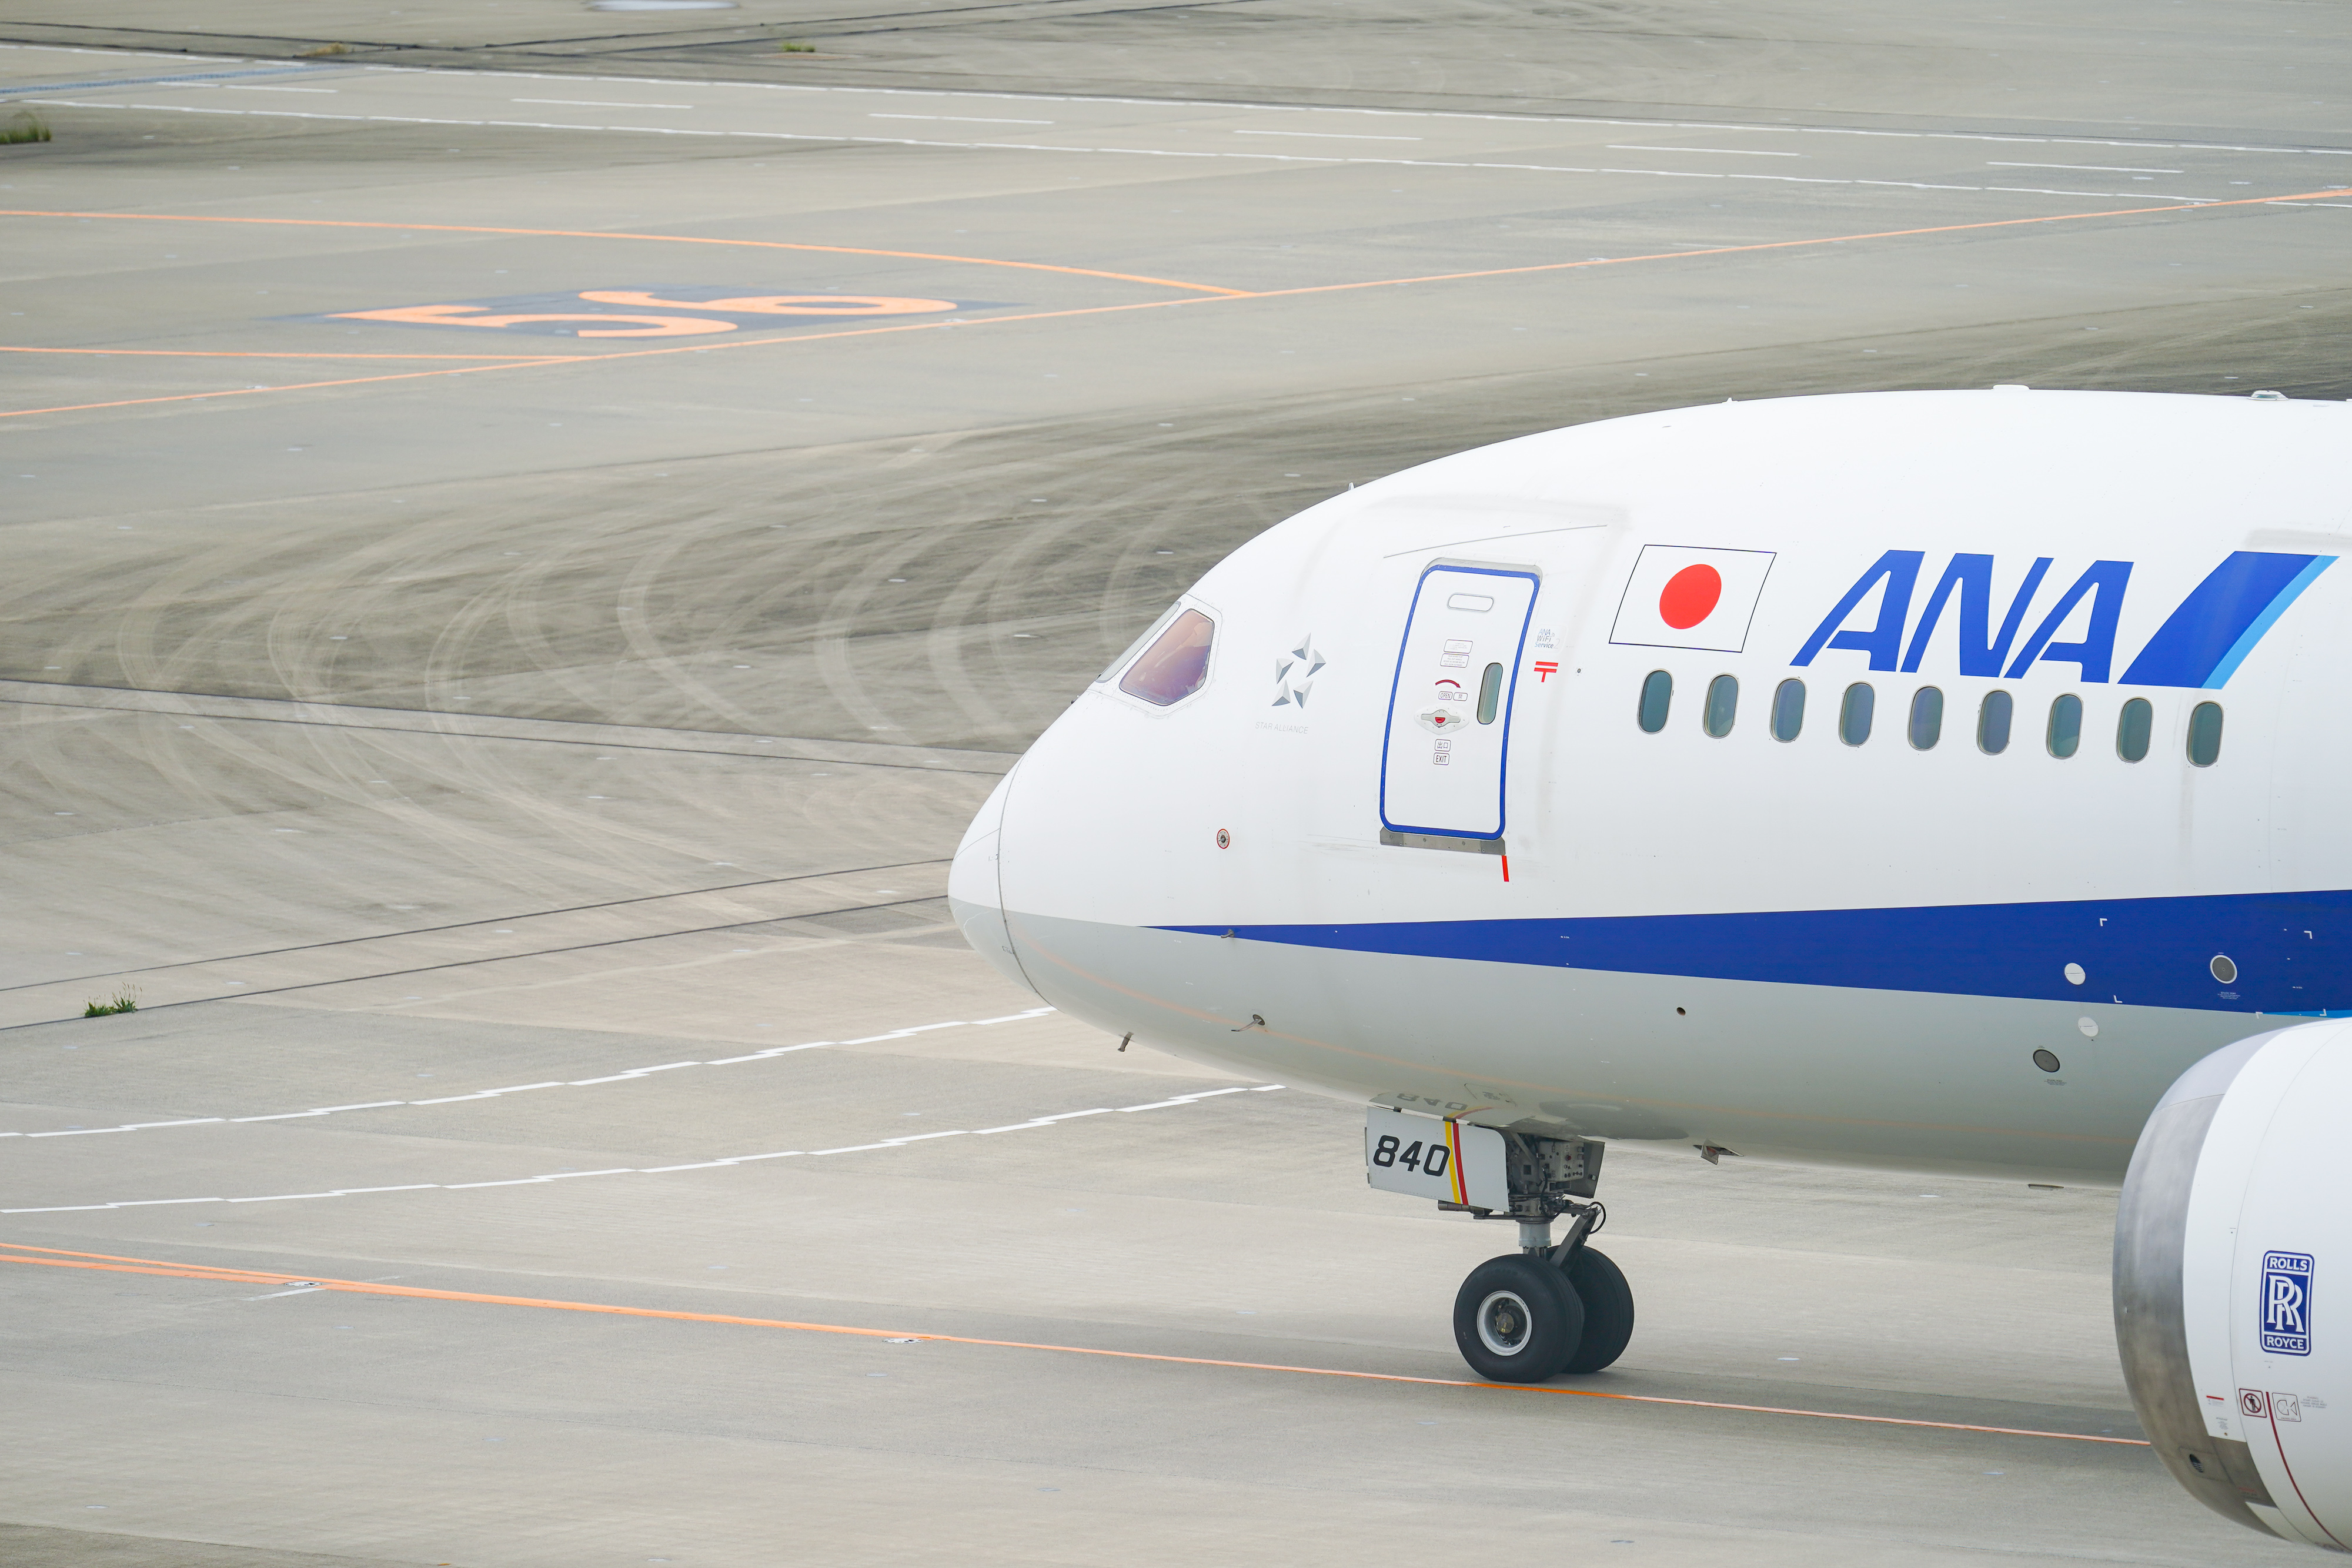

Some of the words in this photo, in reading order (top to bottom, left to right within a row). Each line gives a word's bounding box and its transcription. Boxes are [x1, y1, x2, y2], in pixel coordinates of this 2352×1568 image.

[324, 290, 958, 337] 56
[1789, 549, 2134, 684] ANA
[1534, 641, 1554, 649] Service
[1255, 721, 1273, 730] STAR
[1274, 724, 1309, 734] ALLIANCE
[1435, 755, 1447, 763] EXIT
[1373, 1135, 1450, 1177] 840
[2269, 1256, 2308, 1271] ROLLS
[2266, 1336, 2304, 1349] ROYCE
